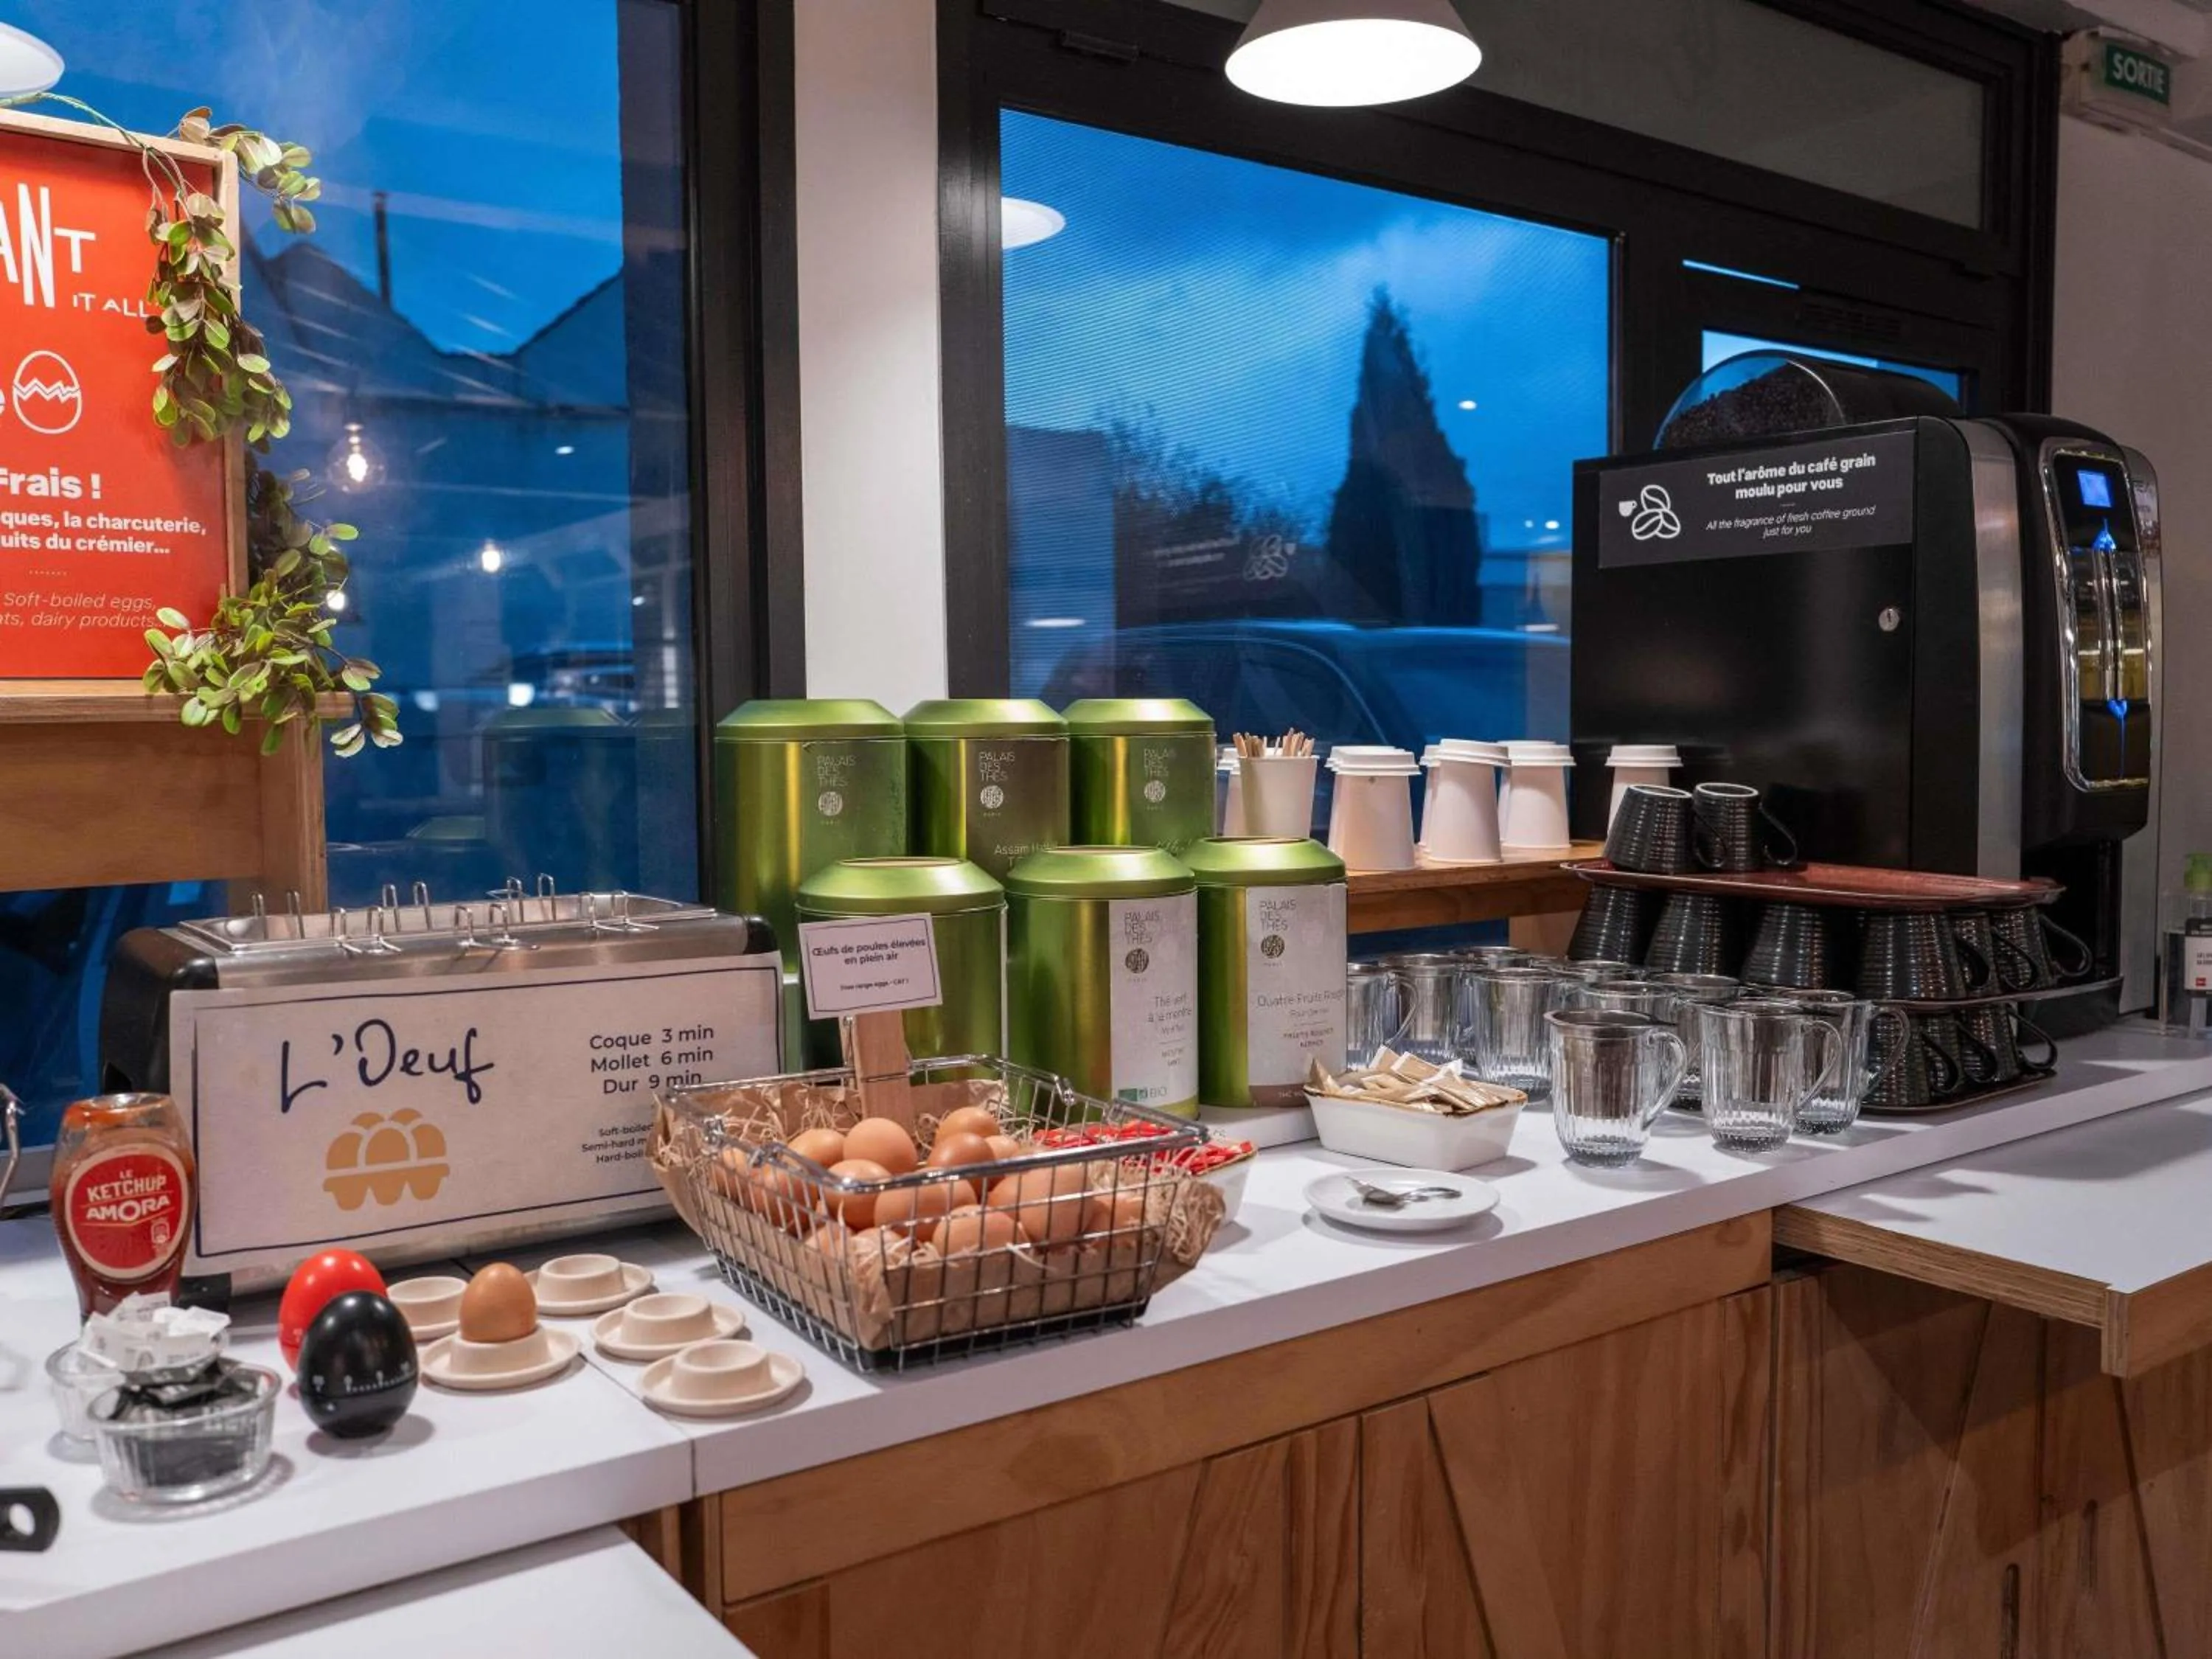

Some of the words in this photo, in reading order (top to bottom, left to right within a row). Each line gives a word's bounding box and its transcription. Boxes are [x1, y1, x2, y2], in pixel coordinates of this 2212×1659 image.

[2113, 52, 2164, 94] SORTIE
[73, 293, 96, 312] IT
[102, 298, 150, 317] ALL
[1707, 472, 1736, 485] Tout
[1738, 465, 1787, 481] l'arôme
[1789, 462, 1805, 476] du
[1807, 456, 1838, 473] café
[1840, 453, 1876, 473] grain
[1735, 481, 1775, 499] moulu
[1777, 480, 1807, 498] pour
[1810, 477, 1843, 490] vous
[63, 512, 81, 526] la
[86, 513, 206, 535] charcuterie,
[1706, 519, 1717, 531] All
[1719, 519, 1732, 529] the
[1733, 515, 1773, 529] fragrance
[1775, 512, 1787, 525] of
[1787, 512, 1809, 523] fresh
[1810, 507, 1841, 521] coffee
[1842, 504, 1877, 520] ground
[1762, 526, 1778, 539] just
[1781, 525, 1793, 536] for
[1795, 524, 1812, 536] you
[1, 531, 41, 549] uits
[46, 533, 72, 550] du
[76, 535, 170, 554] crémier...
[4, 592, 105, 608] Soft-boiled
[111, 596, 157, 611] eggs,
[31, 612, 75, 630] dairy
[817, 755, 857, 766] PALAIS
[978, 751, 1015, 762] PALAIS
[1144, 748, 1177, 759] PALA
[817, 765, 840, 775] DES
[979, 762, 1001, 772] DES
[994, 844, 1029, 855] Assam
[1259, 899, 1298, 911] PALAIS
[1124, 911, 1161, 922] PALAIS
[1260, 911, 1281, 921] DES
[1125, 922, 1146, 933] DES
[813, 945, 840, 957] Œufs
[841, 945, 854, 954] de
[856, 942, 888, 954] poules
[891, 938, 926, 950] élevées
[844, 956, 858, 965] en
[860, 953, 884, 965] plein
[887, 951, 900, 961] air
[1257, 994, 1295, 1008] Quatre
[1297, 992, 1322, 1004] Fruits
[590, 1033, 652, 1050] Coque
[661, 1028, 673, 1043] 3
[678, 1025, 714, 1042] min
[591, 1054, 650, 1073] Mollet
[661, 1051, 672, 1065] 6
[678, 1046, 714, 1064] min
[603, 1078, 639, 1094] Dur
[649, 1074, 660, 1089] 9
[666, 1069, 702, 1088] min
[1150, 1086, 1168, 1098] BIO
[582, 1137, 636, 1152] Semi-hard
[119, 1169, 133, 1179] LE
[87, 1174, 168, 1203] KETCHUP
[86, 1194, 171, 1222] AMORA
